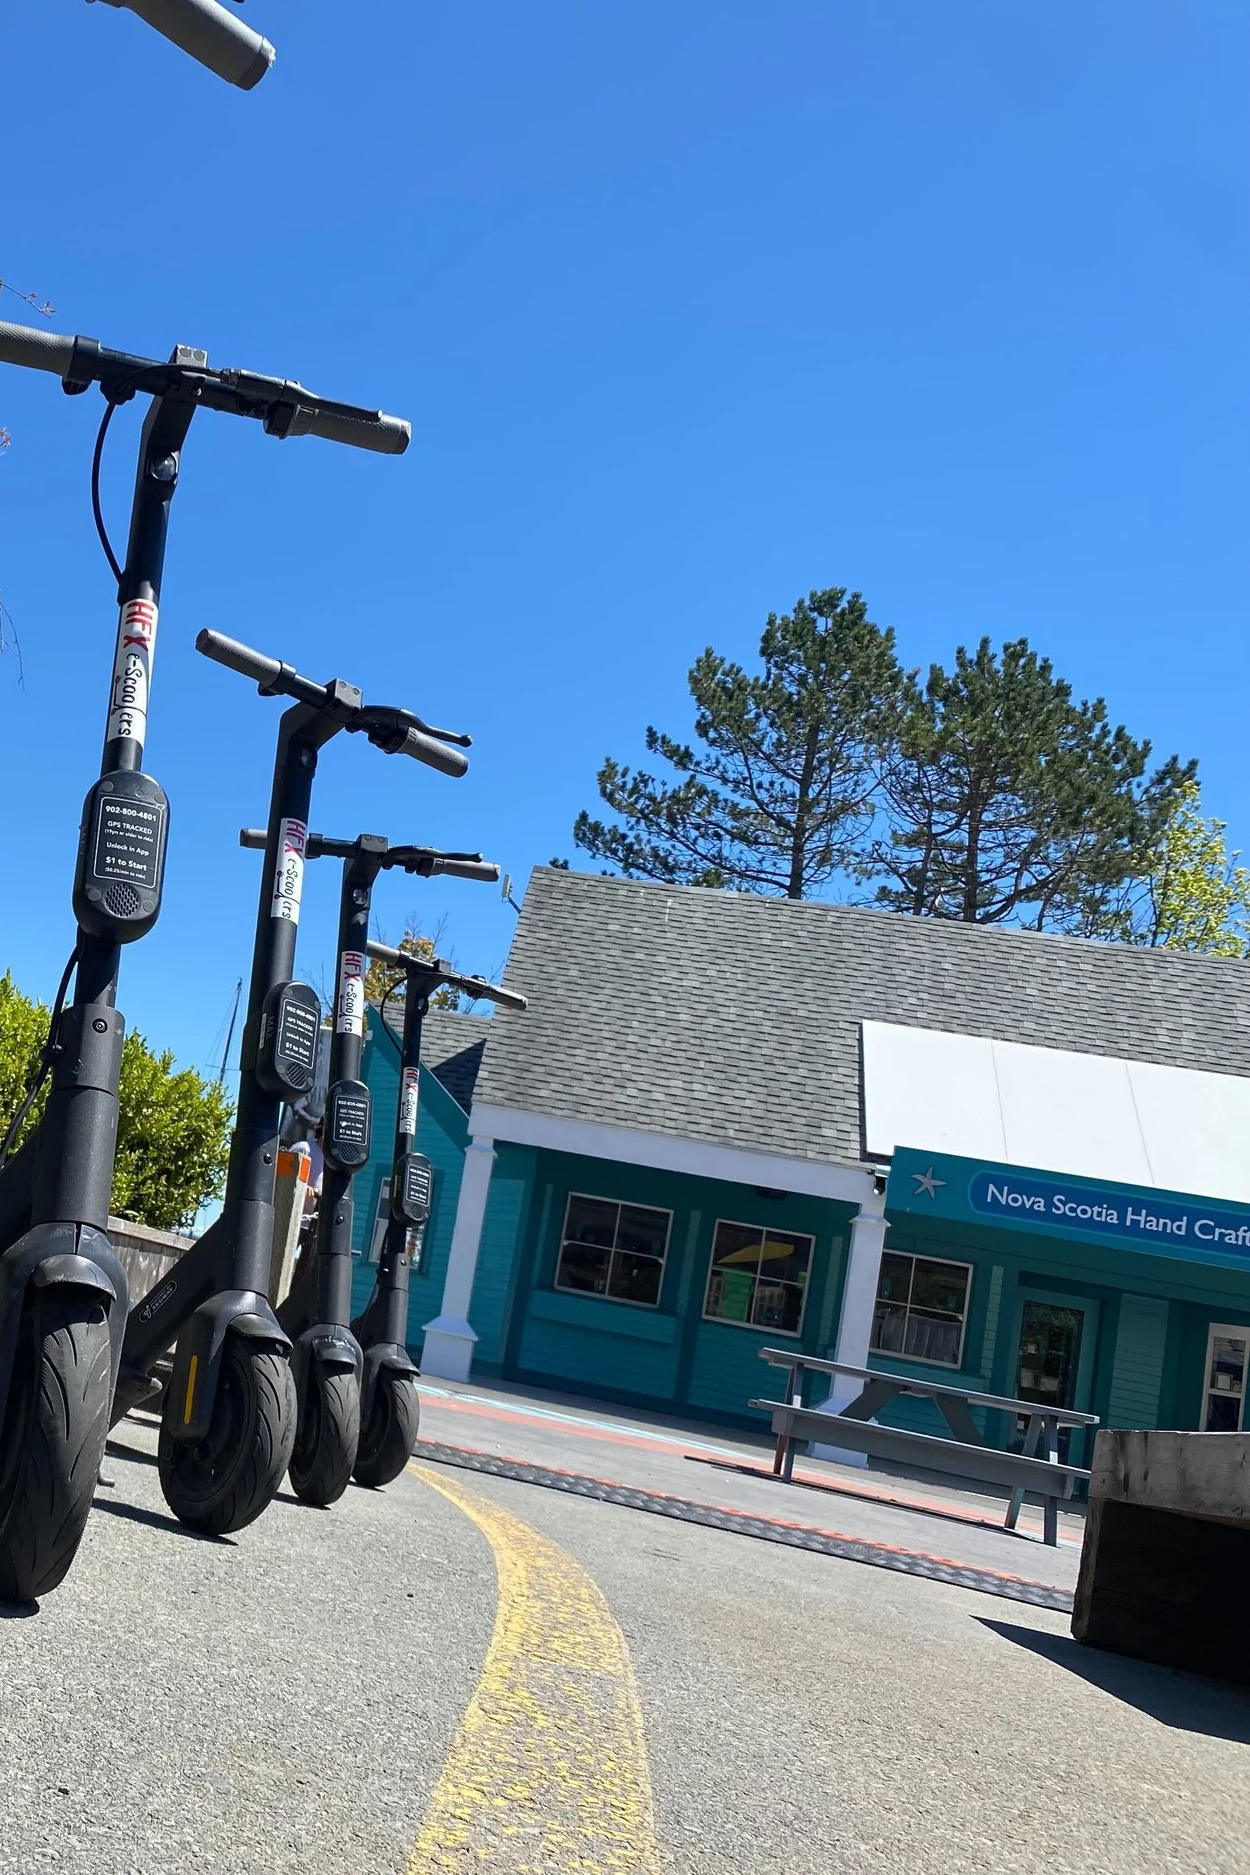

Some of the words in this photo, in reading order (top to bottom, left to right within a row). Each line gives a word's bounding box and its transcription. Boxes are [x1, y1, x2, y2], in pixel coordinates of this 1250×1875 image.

[123, 601, 154, 652] HFX
[105, 805, 157, 822] 902-800-4801
[107, 821, 121, 829] GPS
[122, 822, 153, 835] TRACKED
[284, 820, 305, 859] HFX
[106, 841, 128, 851] Unlock
[136, 847, 149, 856] App
[105, 856, 116, 864] $1
[118, 857, 127, 866] to
[128, 860, 147, 871] Start
[344, 952, 362, 982] HFX
[986, 1183, 1046, 1212] Nova
[1051, 1195, 1119, 1225] Scotia
[1125, 1207, 1187, 1237] Hand
